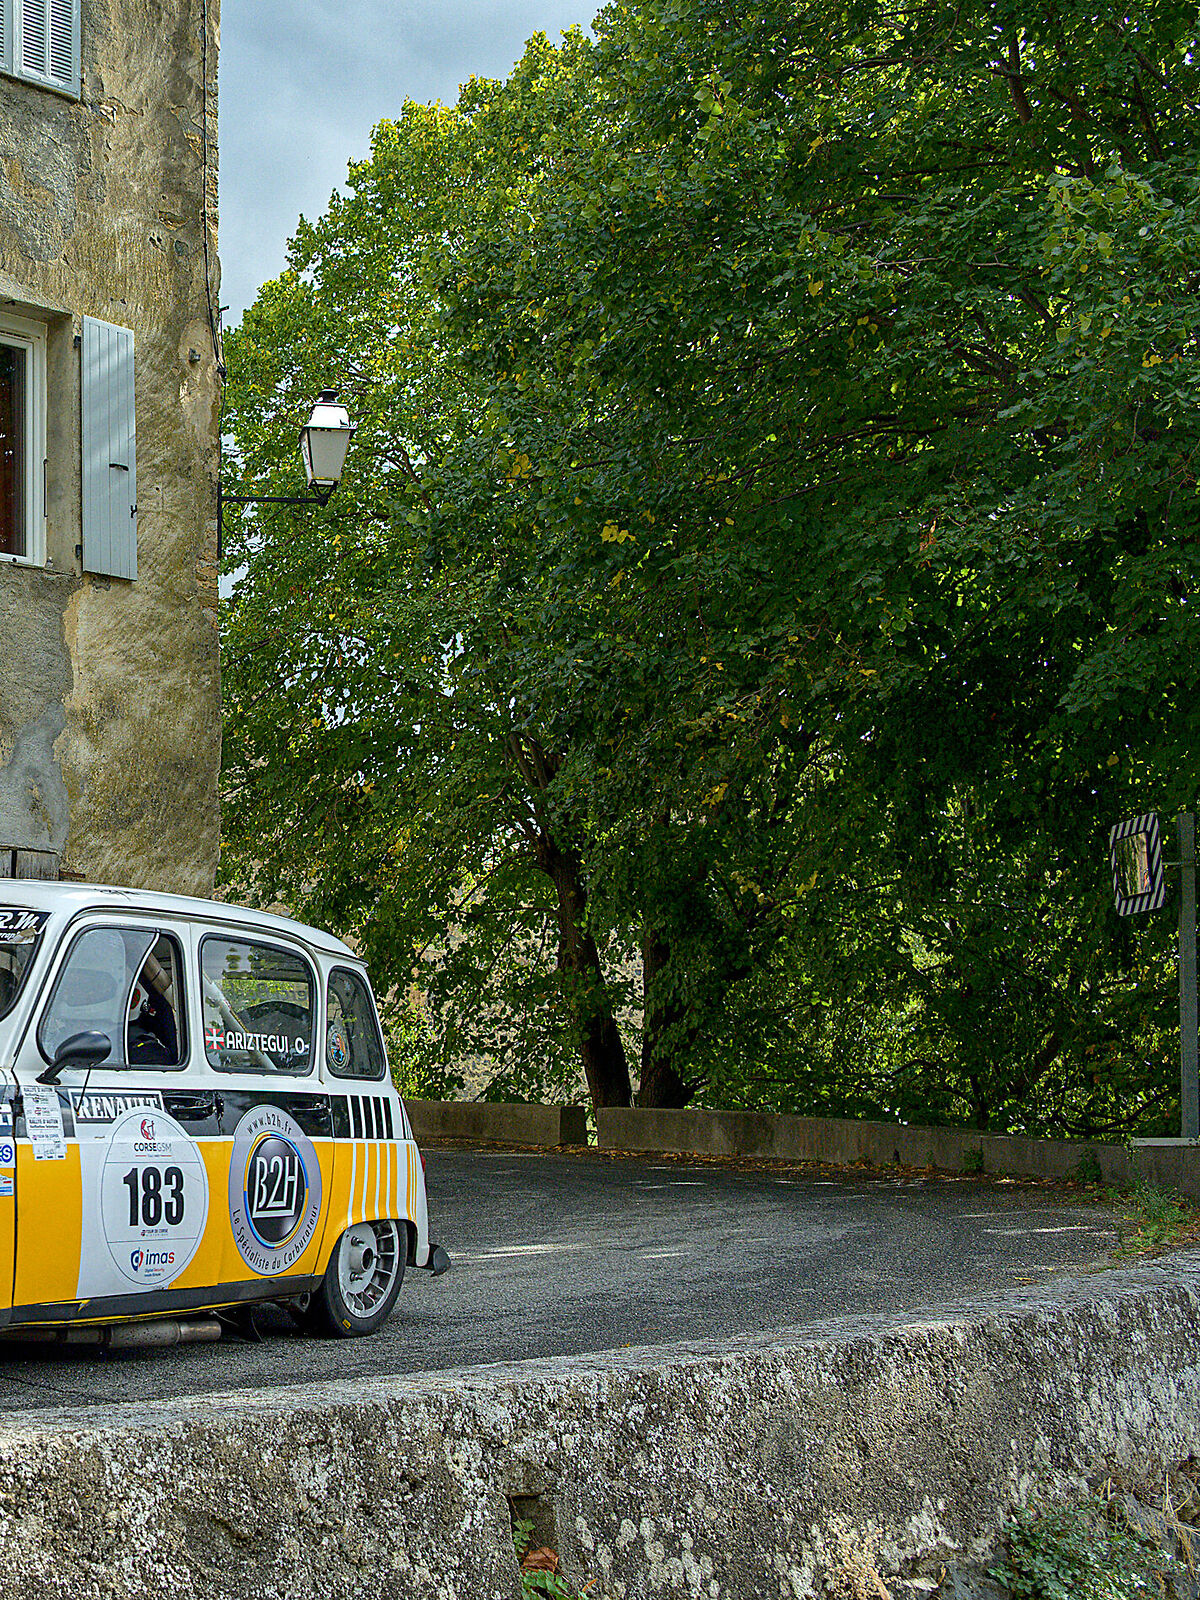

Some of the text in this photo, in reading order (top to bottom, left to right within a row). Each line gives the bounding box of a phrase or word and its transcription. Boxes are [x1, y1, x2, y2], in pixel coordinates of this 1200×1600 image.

[226, 1030, 289, 1054] ARIZTEGUI
[74, 1096, 160, 1119] RENAULT
[246, 1112, 292, 1136] www.b2h.fr
[1, 1146, 12, 1160] S
[122, 1166, 185, 1227] 183
[253, 1155, 299, 1217] B2H
[231, 1204, 319, 1271] Le Spécialiste du Carburateur
[145, 1248, 175, 1266] imas
